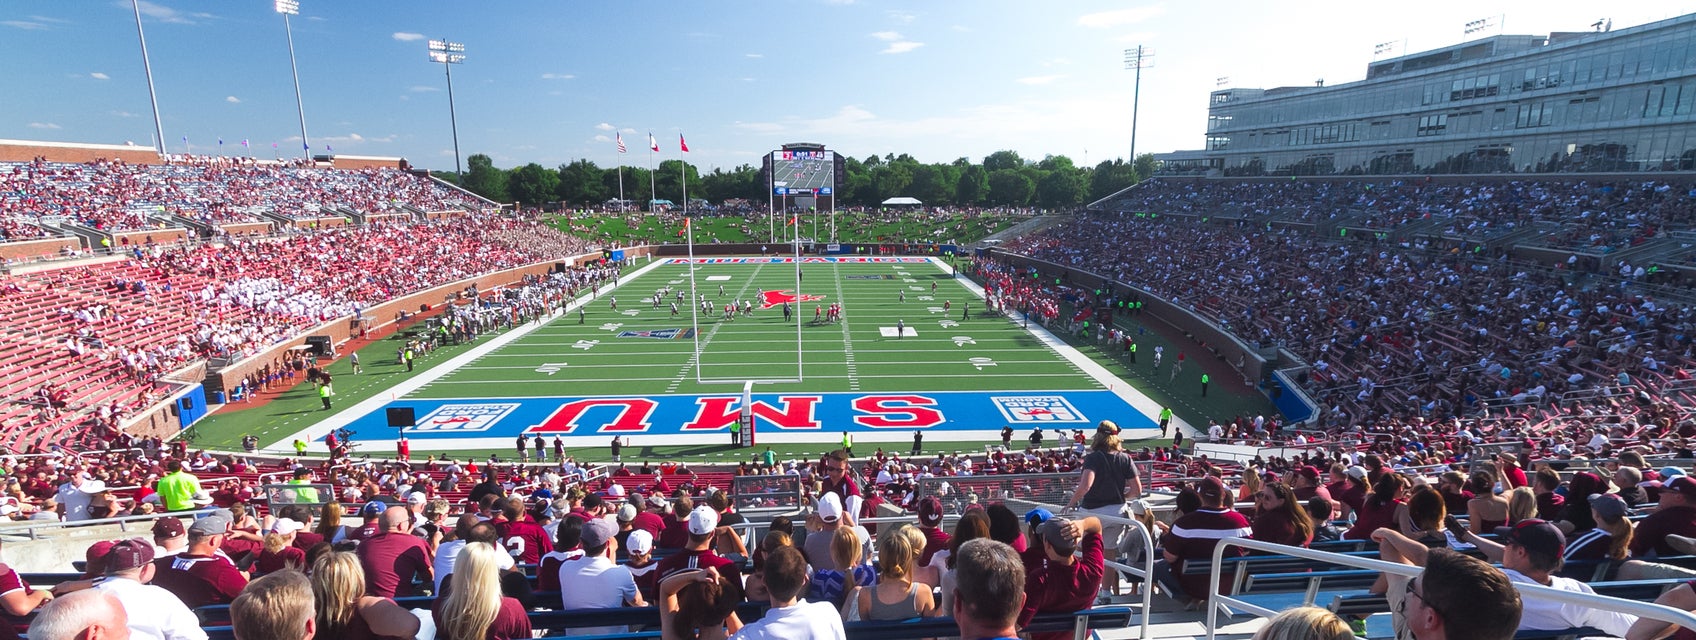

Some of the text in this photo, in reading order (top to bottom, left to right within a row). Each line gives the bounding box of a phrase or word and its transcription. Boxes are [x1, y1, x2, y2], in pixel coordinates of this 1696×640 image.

[571, 340, 599, 348] 20
[952, 336, 977, 346] 20
[969, 357, 997, 367] 10
[535, 363, 567, 373] 10
[522, 395, 946, 433] SMU
